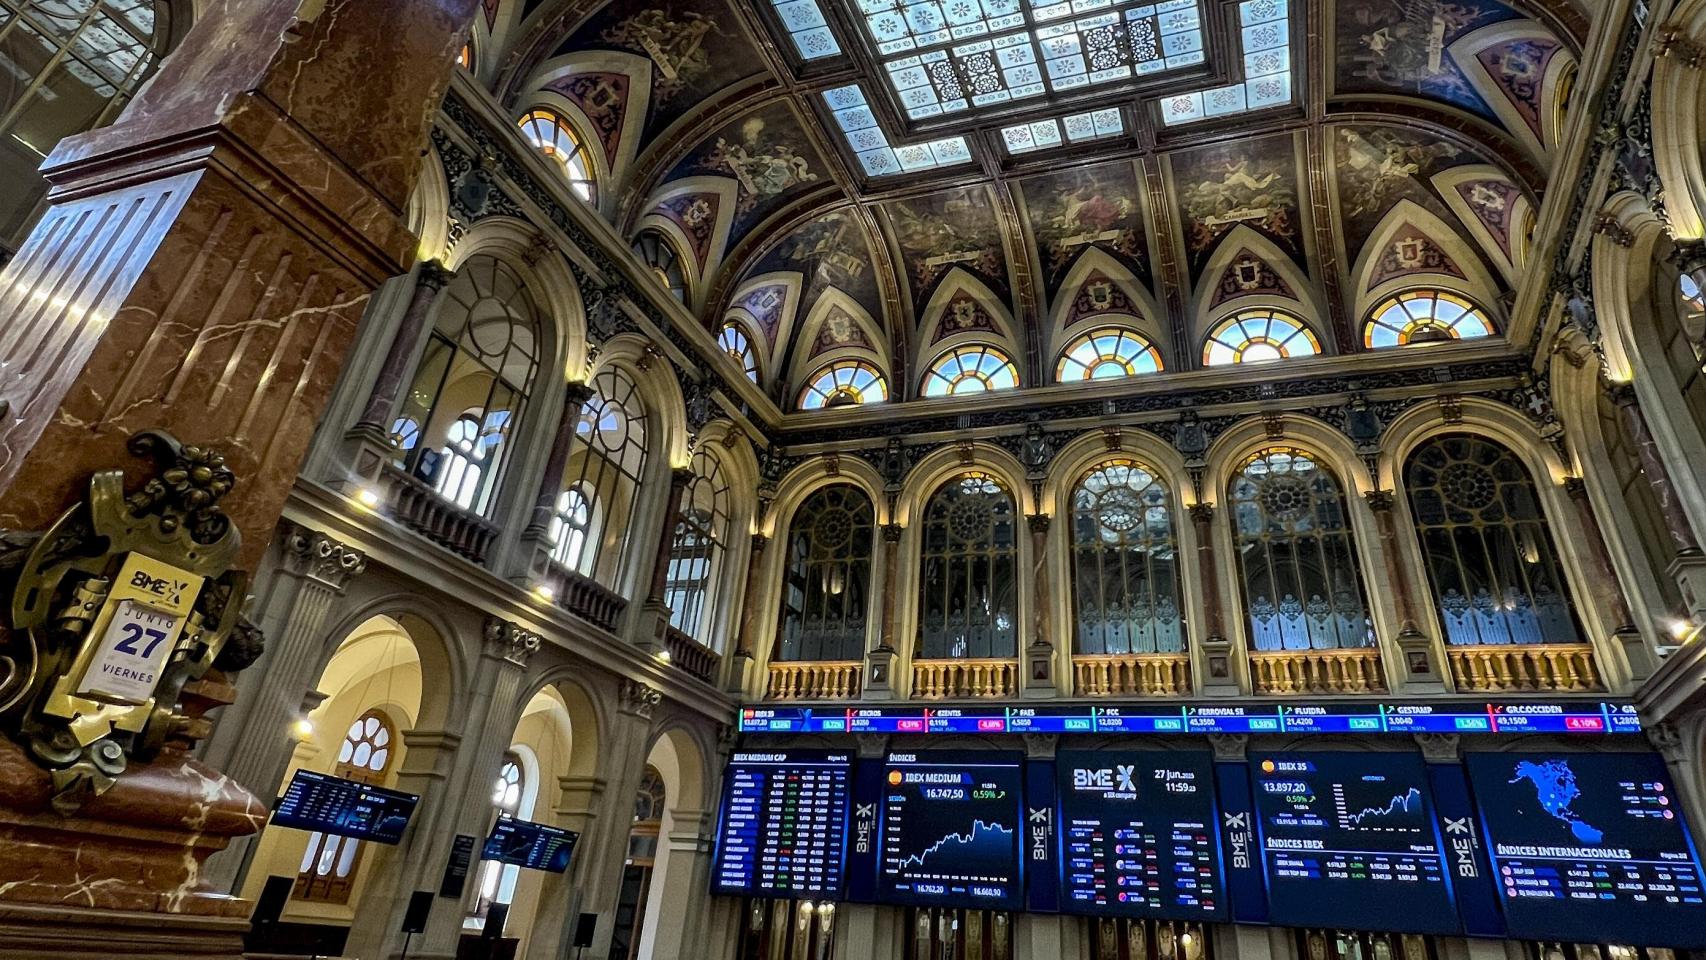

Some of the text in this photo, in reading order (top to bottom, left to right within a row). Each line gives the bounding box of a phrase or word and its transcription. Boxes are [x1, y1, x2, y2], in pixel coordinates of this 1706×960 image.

[124, 608, 174, 629] JUNIO
[113, 622, 168, 659] 27
[102, 663, 154, 683] VIERNES
[1198, 708, 1234, 716] FERROVIAL
[1295, 707, 1326, 715] FLUIDRA
[1397, 706, 1433, 714] GESTAMP
[1286, 718, 1313, 726] 21,4200
[1497, 717, 1528, 725] 49,1500
[889, 753, 916, 762] ÍNDICES
[1278, 762, 1308, 771] IBEX 35
[905, 773, 962, 783] IBEX MEDIUM
[1073, 768, 1114, 786] BME
[1154, 769, 1165, 779] 27
[1263, 783, 1306, 793] 13.897,20
[926, 789, 963, 800] 16.747,50
[973, 790, 996, 799] 0,59%
[1286, 795, 1308, 803] 0,59%
[856, 820, 869, 853] BME
[1032, 825, 1046, 860] BME
[1266, 837, 1324, 849] ÍNDICES IBEX
[1229, 831, 1247, 868] BME
[1497, 843, 1632, 859] ÍNDICES INTERNACIONALES
[1453, 837, 1475, 878] BME
